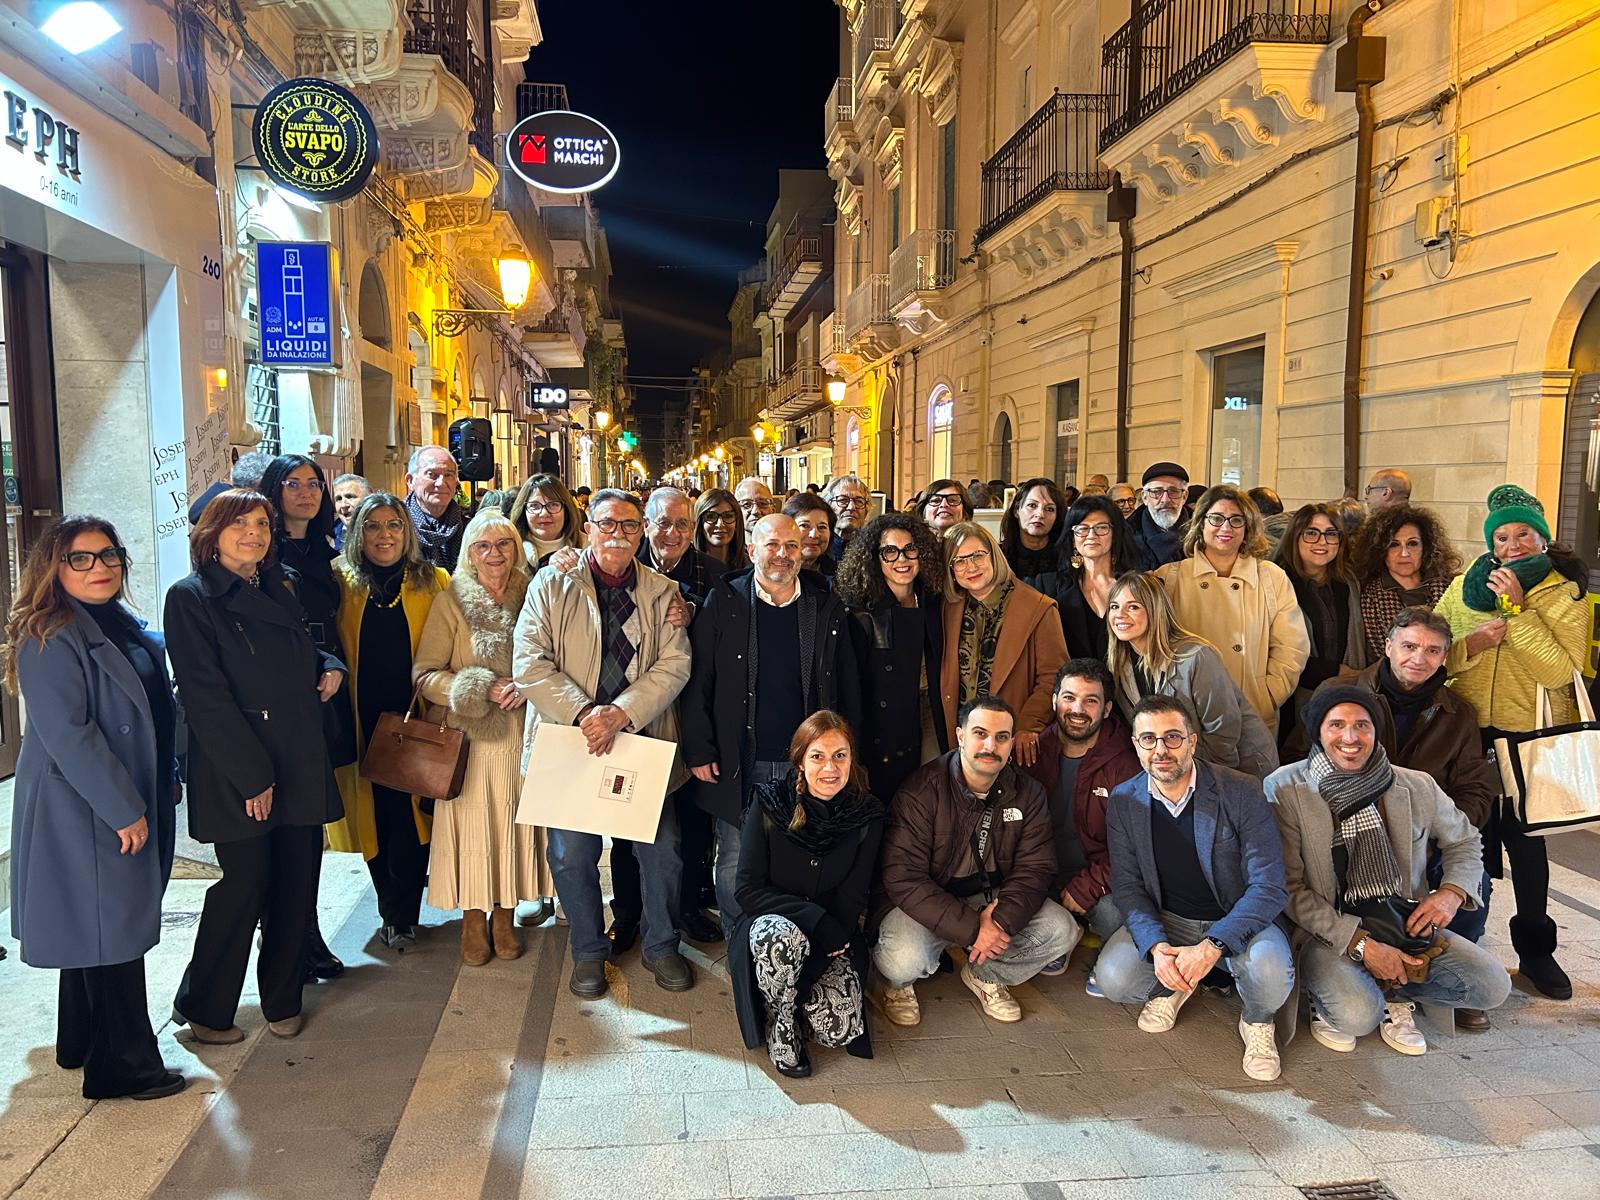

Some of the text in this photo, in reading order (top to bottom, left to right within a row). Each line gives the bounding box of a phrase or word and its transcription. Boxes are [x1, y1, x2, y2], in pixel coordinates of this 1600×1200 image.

[275, 94, 351, 124] CLOUDING
[288, 122, 340, 133] L'ARTE DELLO
[285, 131, 343, 152] SVAPO
[553, 151, 604, 165] MARCHI
[292, 165, 338, 182] STORE
[40, 175, 79, 206] 0-16 anni
[203, 255, 221, 280] 260
[266, 340, 327, 352] LIQUIDI
[280, 351, 327, 359] INALAZIONE
